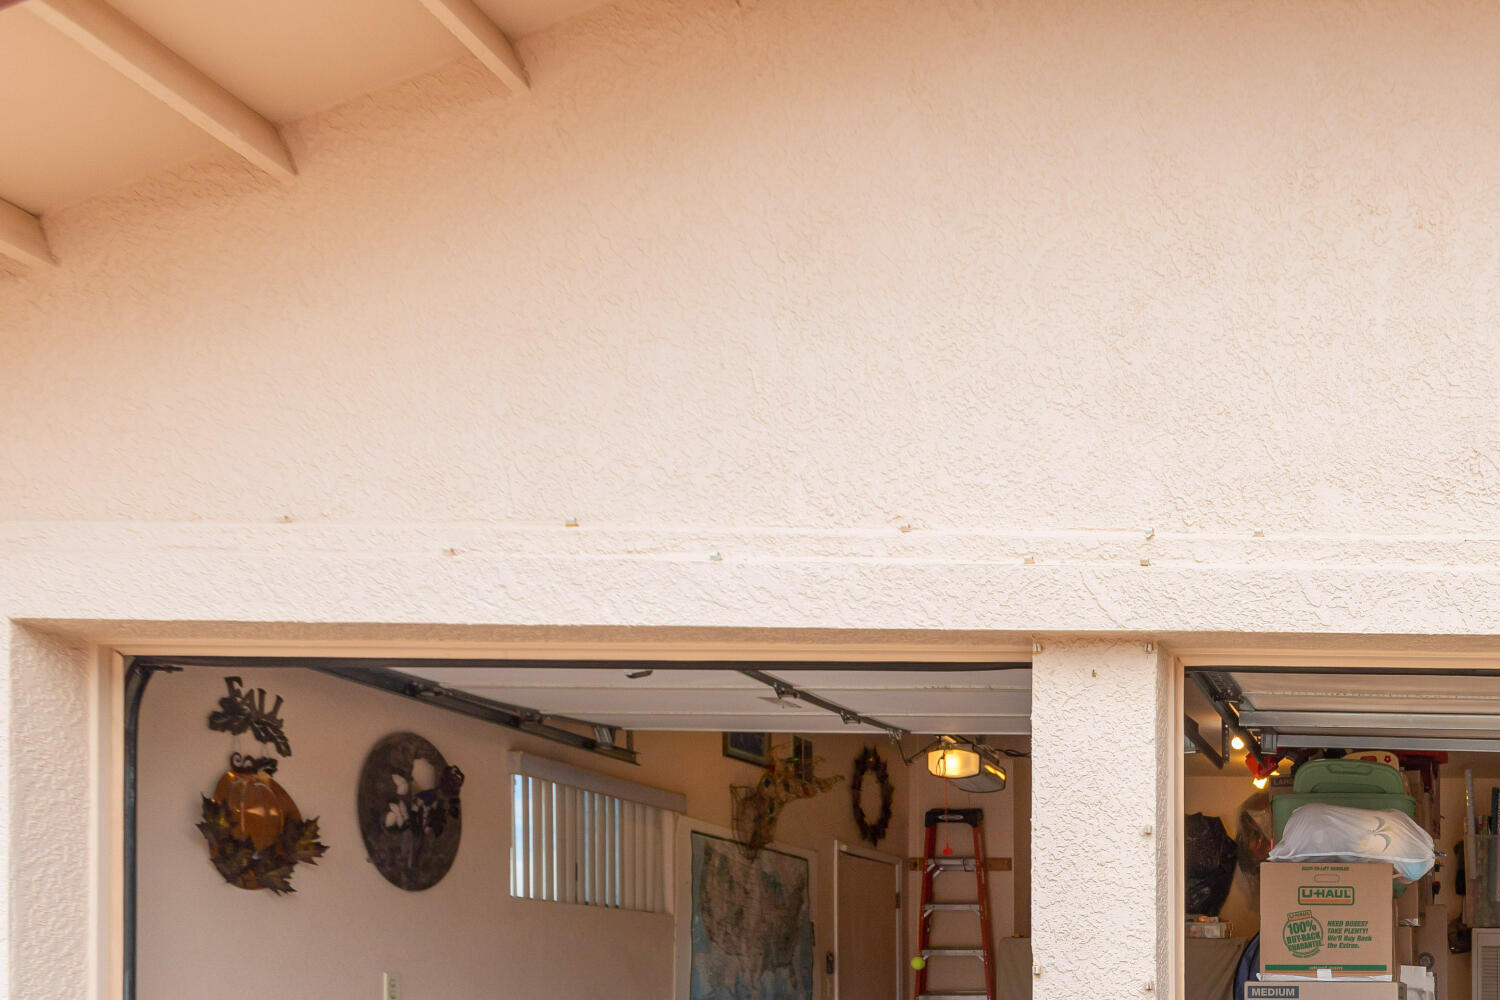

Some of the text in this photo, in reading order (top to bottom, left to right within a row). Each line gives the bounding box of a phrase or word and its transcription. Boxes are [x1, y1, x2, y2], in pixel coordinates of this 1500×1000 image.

[1301, 889, 1351, 898] U-HAUL
[1287, 920, 1317, 935] 100%
[1286, 931, 1321, 944] BUY-BACK
[1251, 987, 1296, 997] MEDIUM
